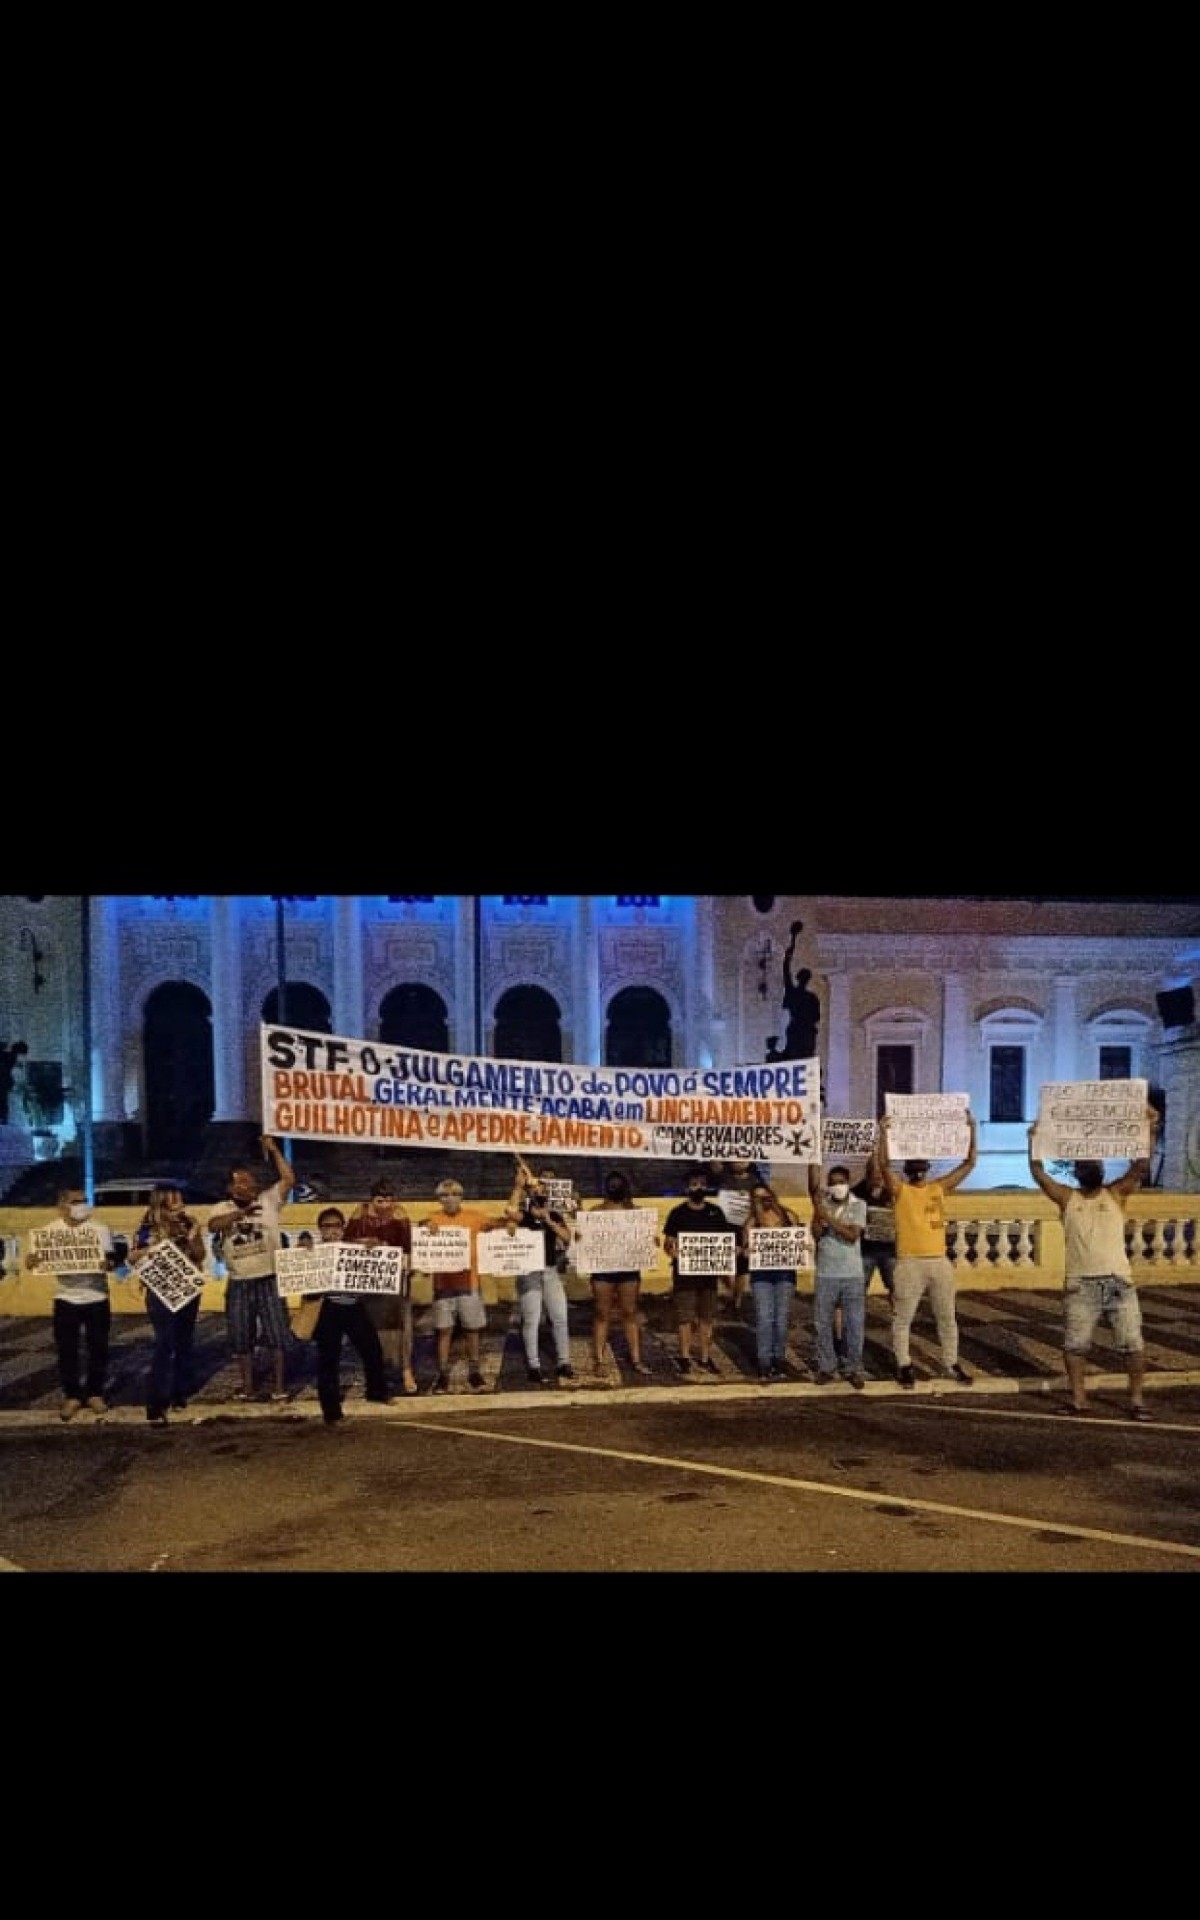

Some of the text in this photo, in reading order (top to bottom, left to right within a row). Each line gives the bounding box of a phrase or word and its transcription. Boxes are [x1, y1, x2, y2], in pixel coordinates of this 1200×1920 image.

[361, 1047, 380, 1074] O
[390, 1053, 574, 1095] JULGAMENTO
[581, 1072, 612, 1094] do
[615, 1072, 680, 1097] POVO
[703, 1065, 808, 1098] SEMPRE
[375, 1078, 534, 1113] GERALMENTE
[541, 1096, 611, 1121] ACABA
[614, 1101, 643, 1121] em
[275, 1101, 424, 1141] GUILHOTINA
[656, 1126, 785, 1146] CONSERVADORES
[671, 1140, 769, 1159] DO BRASIL
[753, 1231, 791, 1239] TODO
[338, 1248, 382, 1257] TODO
